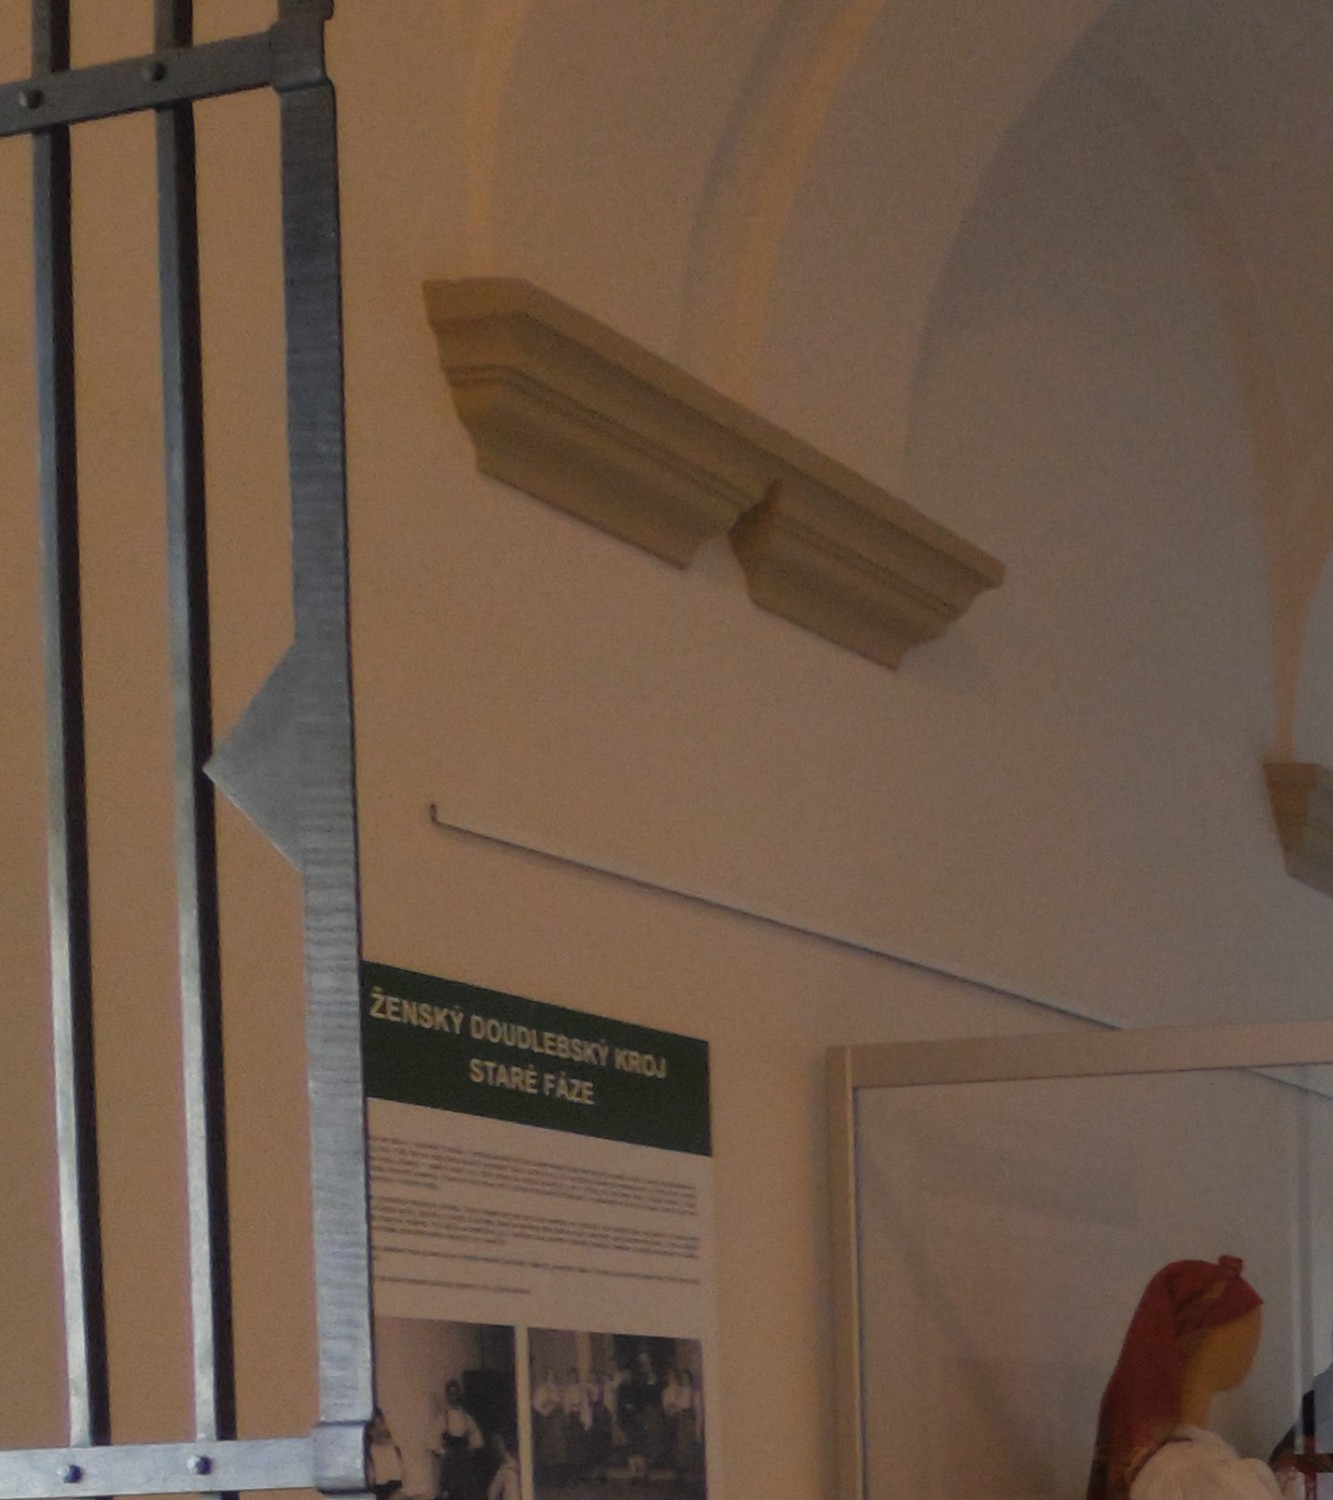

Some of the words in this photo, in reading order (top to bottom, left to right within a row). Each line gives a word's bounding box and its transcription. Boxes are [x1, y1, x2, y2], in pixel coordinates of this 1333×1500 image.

[368, 986, 465, 1035] ŽENSKÝ
[470, 1015, 611, 1067] DOUDLEBSKÝ
[614, 1047, 668, 1080] KROJ
[467, 1058, 540, 1095] STARÉ
[543, 1067, 597, 1105] FÁZE
